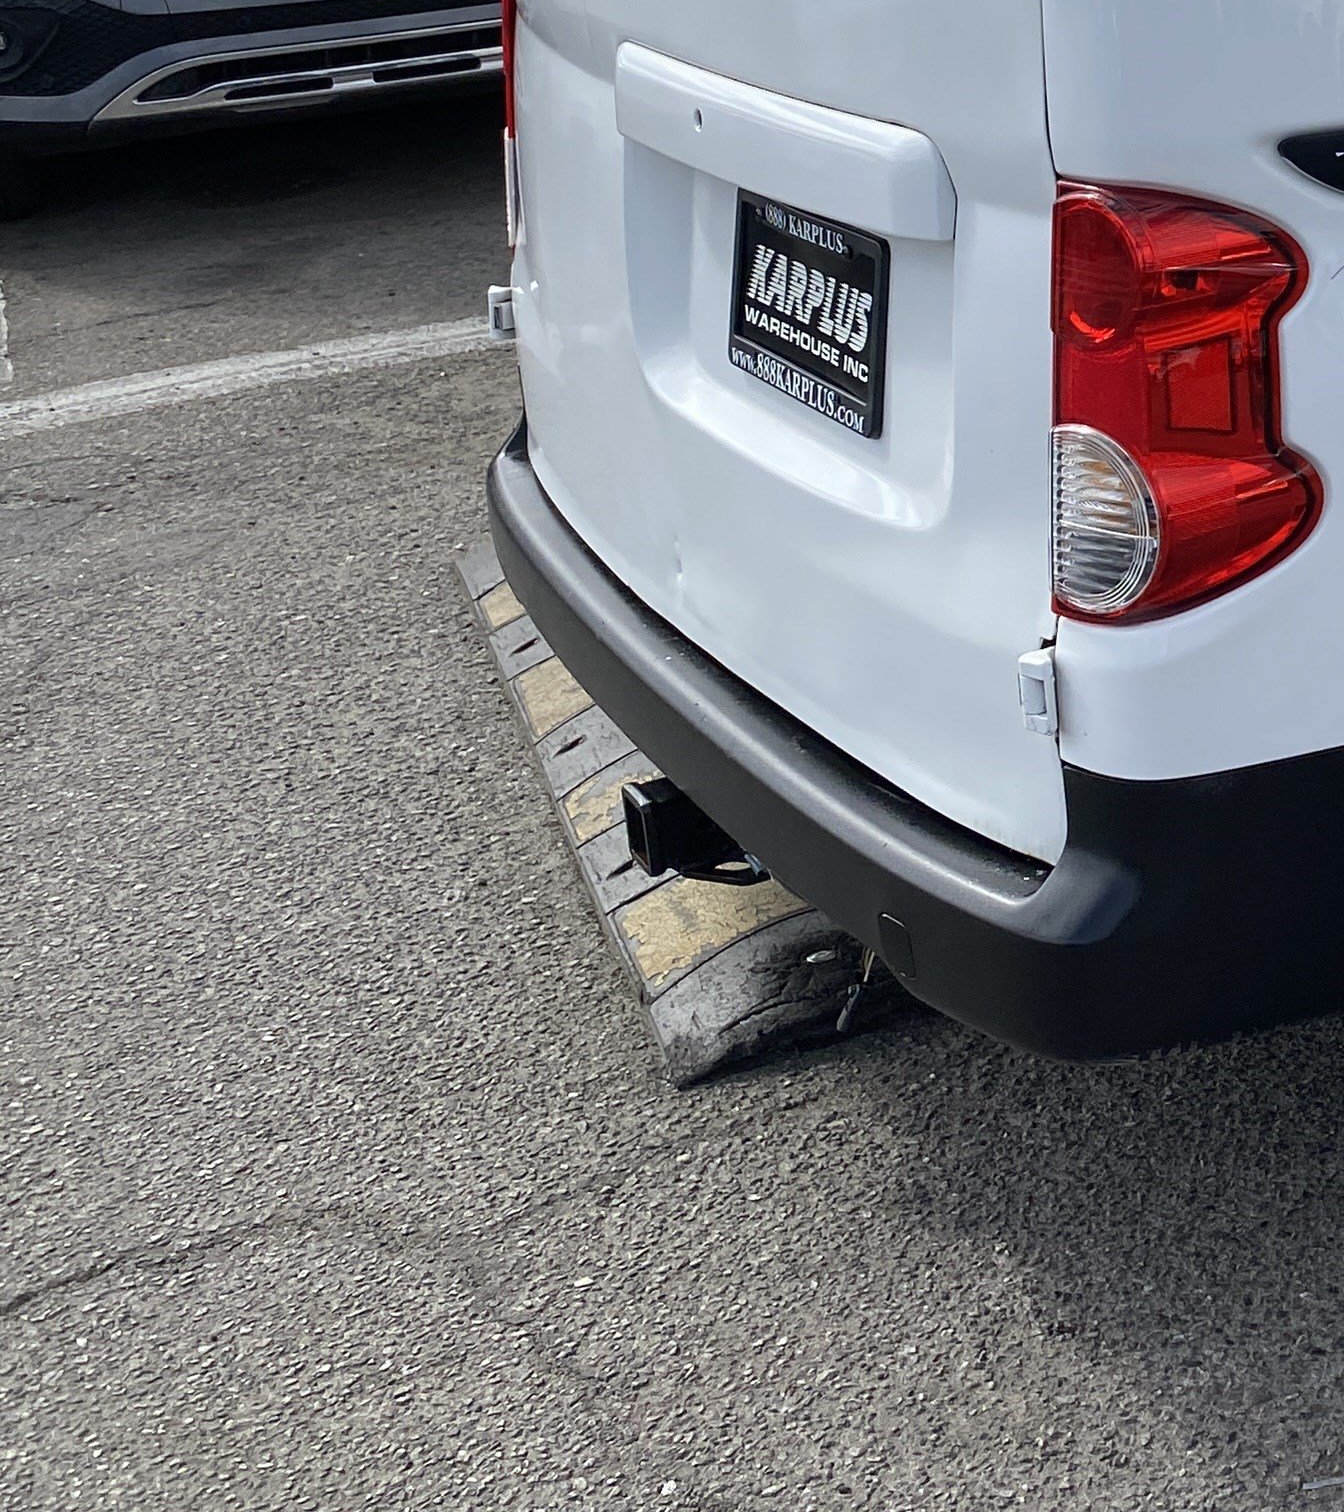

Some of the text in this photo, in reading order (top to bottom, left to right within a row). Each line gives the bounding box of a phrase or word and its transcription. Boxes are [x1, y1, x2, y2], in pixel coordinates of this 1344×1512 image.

[765, 203, 843, 255] (888) KARPLUS
[746, 244, 873, 353] KARPLUS
[744, 304, 869, 382] WAREHOUSE INC
